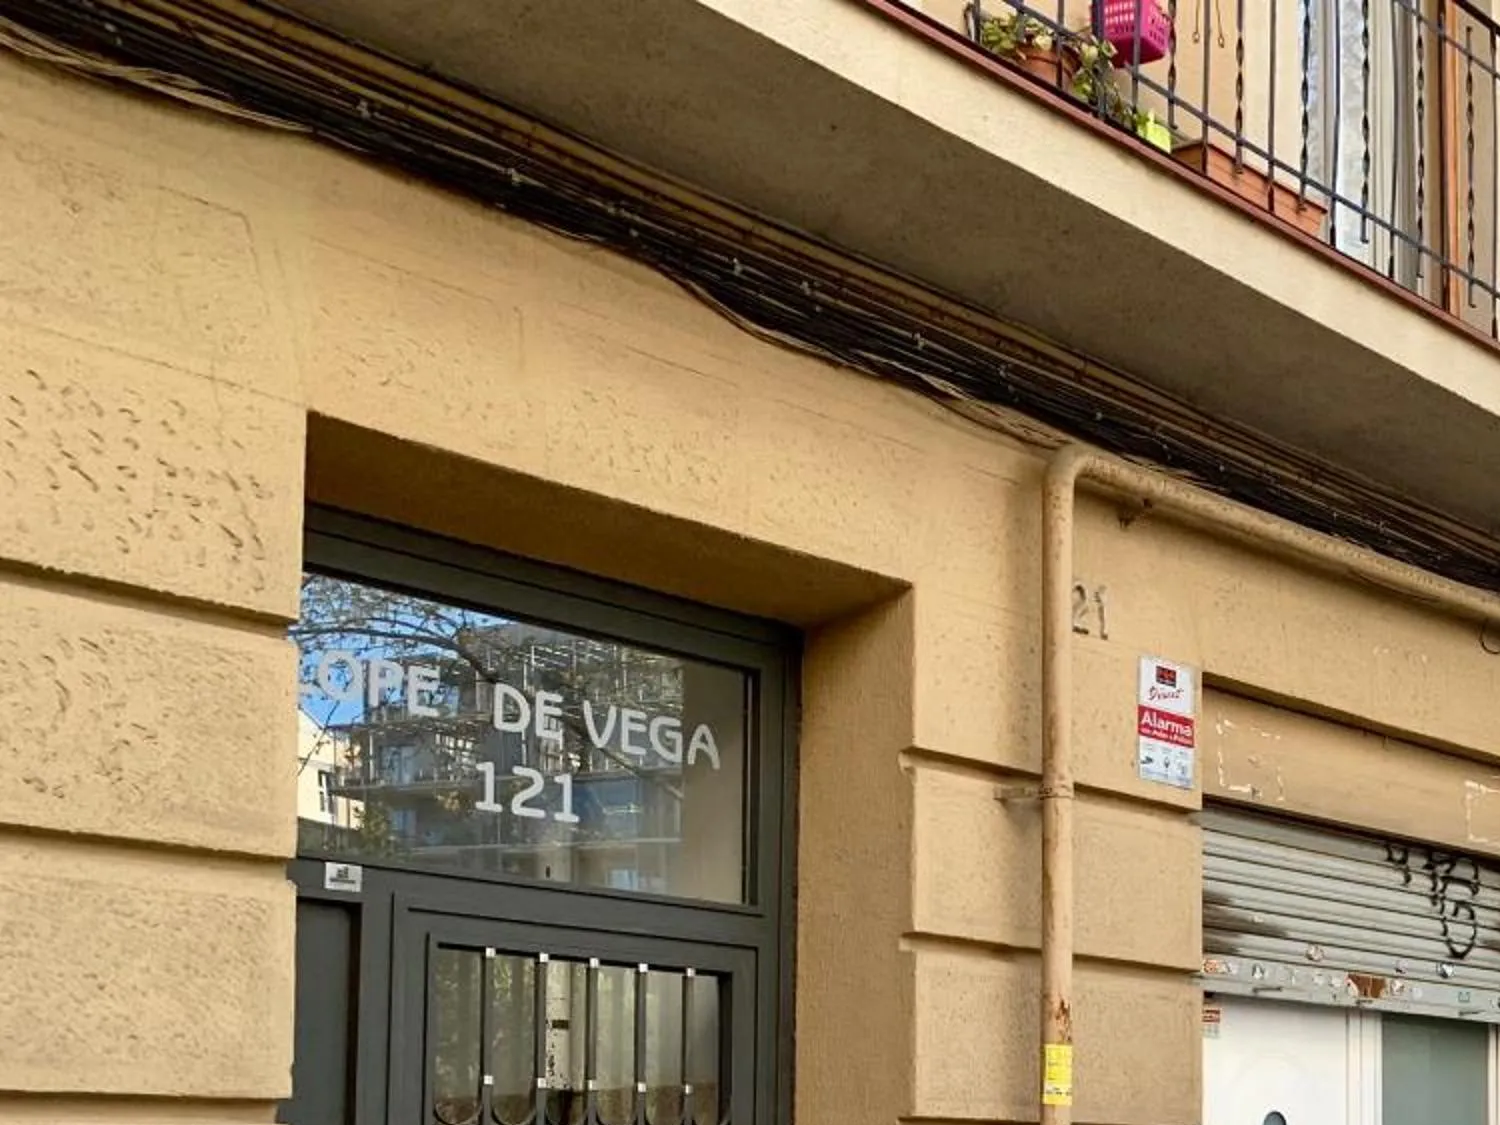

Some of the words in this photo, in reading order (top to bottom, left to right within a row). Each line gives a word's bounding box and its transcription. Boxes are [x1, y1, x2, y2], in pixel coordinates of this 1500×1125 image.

[493, 683, 564, 741] DE
[582, 699, 721, 770] VEGA
[1140, 711, 1193, 737] Alarma
[474, 760, 581, 824] 121
